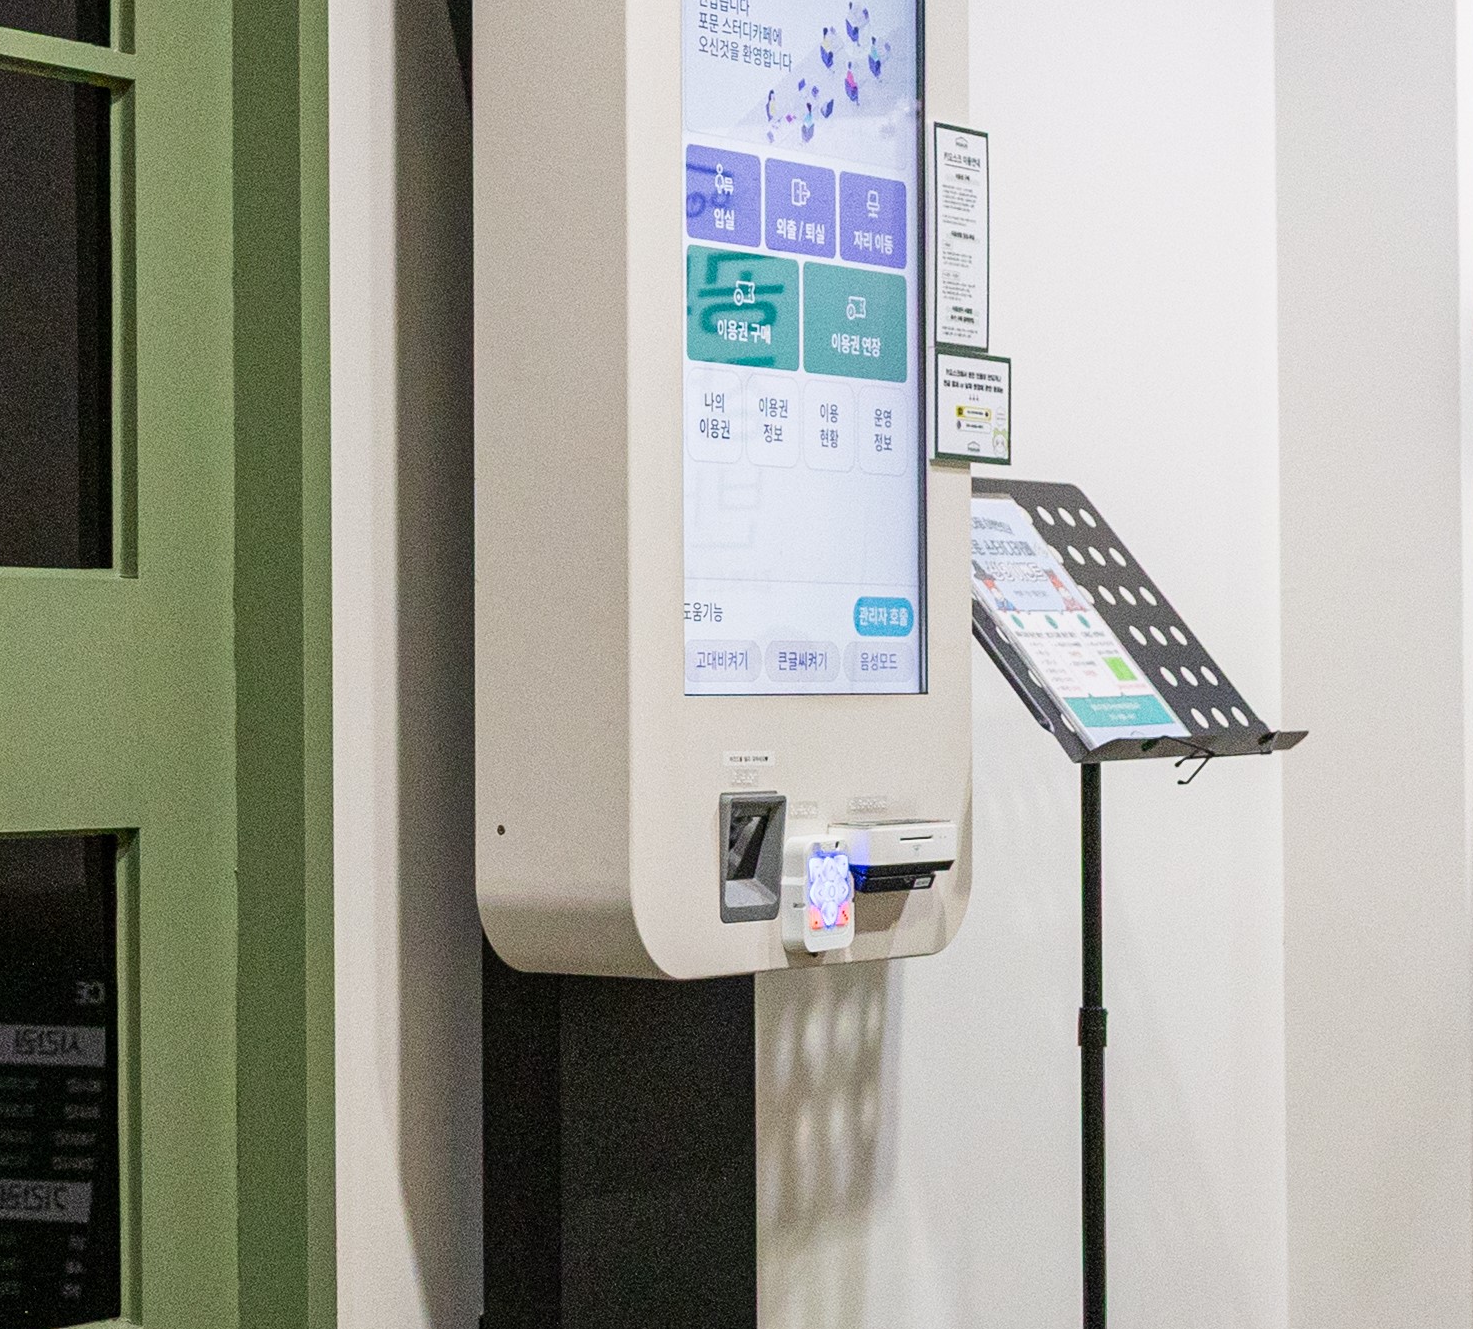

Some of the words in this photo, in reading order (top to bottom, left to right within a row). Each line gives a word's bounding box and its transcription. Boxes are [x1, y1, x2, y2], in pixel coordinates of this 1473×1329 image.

[698, 11, 719, 33] 포문
[722, 18, 782, 47] 스터디카페에
[698, 36, 739, 61] 오신것을
[742, 44, 792, 72] 환영합니다
[714, 208, 735, 230] 입실
[776, 218, 796, 240] 외출
[805, 223, 825, 245] 퇴실
[854, 231, 873, 251] 자리
[874, 234, 894, 255] 이동
[717, 319, 748, 342] 이용권
[750, 324, 771, 345] 구매
[831, 333, 860, 356] 이용권
[862, 338, 881, 358] 연장
[704, 392, 725, 414] 나의
[758, 397, 788, 419] 이용권
[819, 403, 839, 424] 이용
[699, 418, 731, 440] 이용권
[763, 423, 784, 444] 정보
[820, 428, 839, 449] 현황
[874, 433, 893, 453] 정보
[859, 606, 888, 626] 관리자
[890, 608, 909, 627] 호출
[695, 650, 749, 671] 고대비켜기
[860, 652, 898, 671] 음성모드
